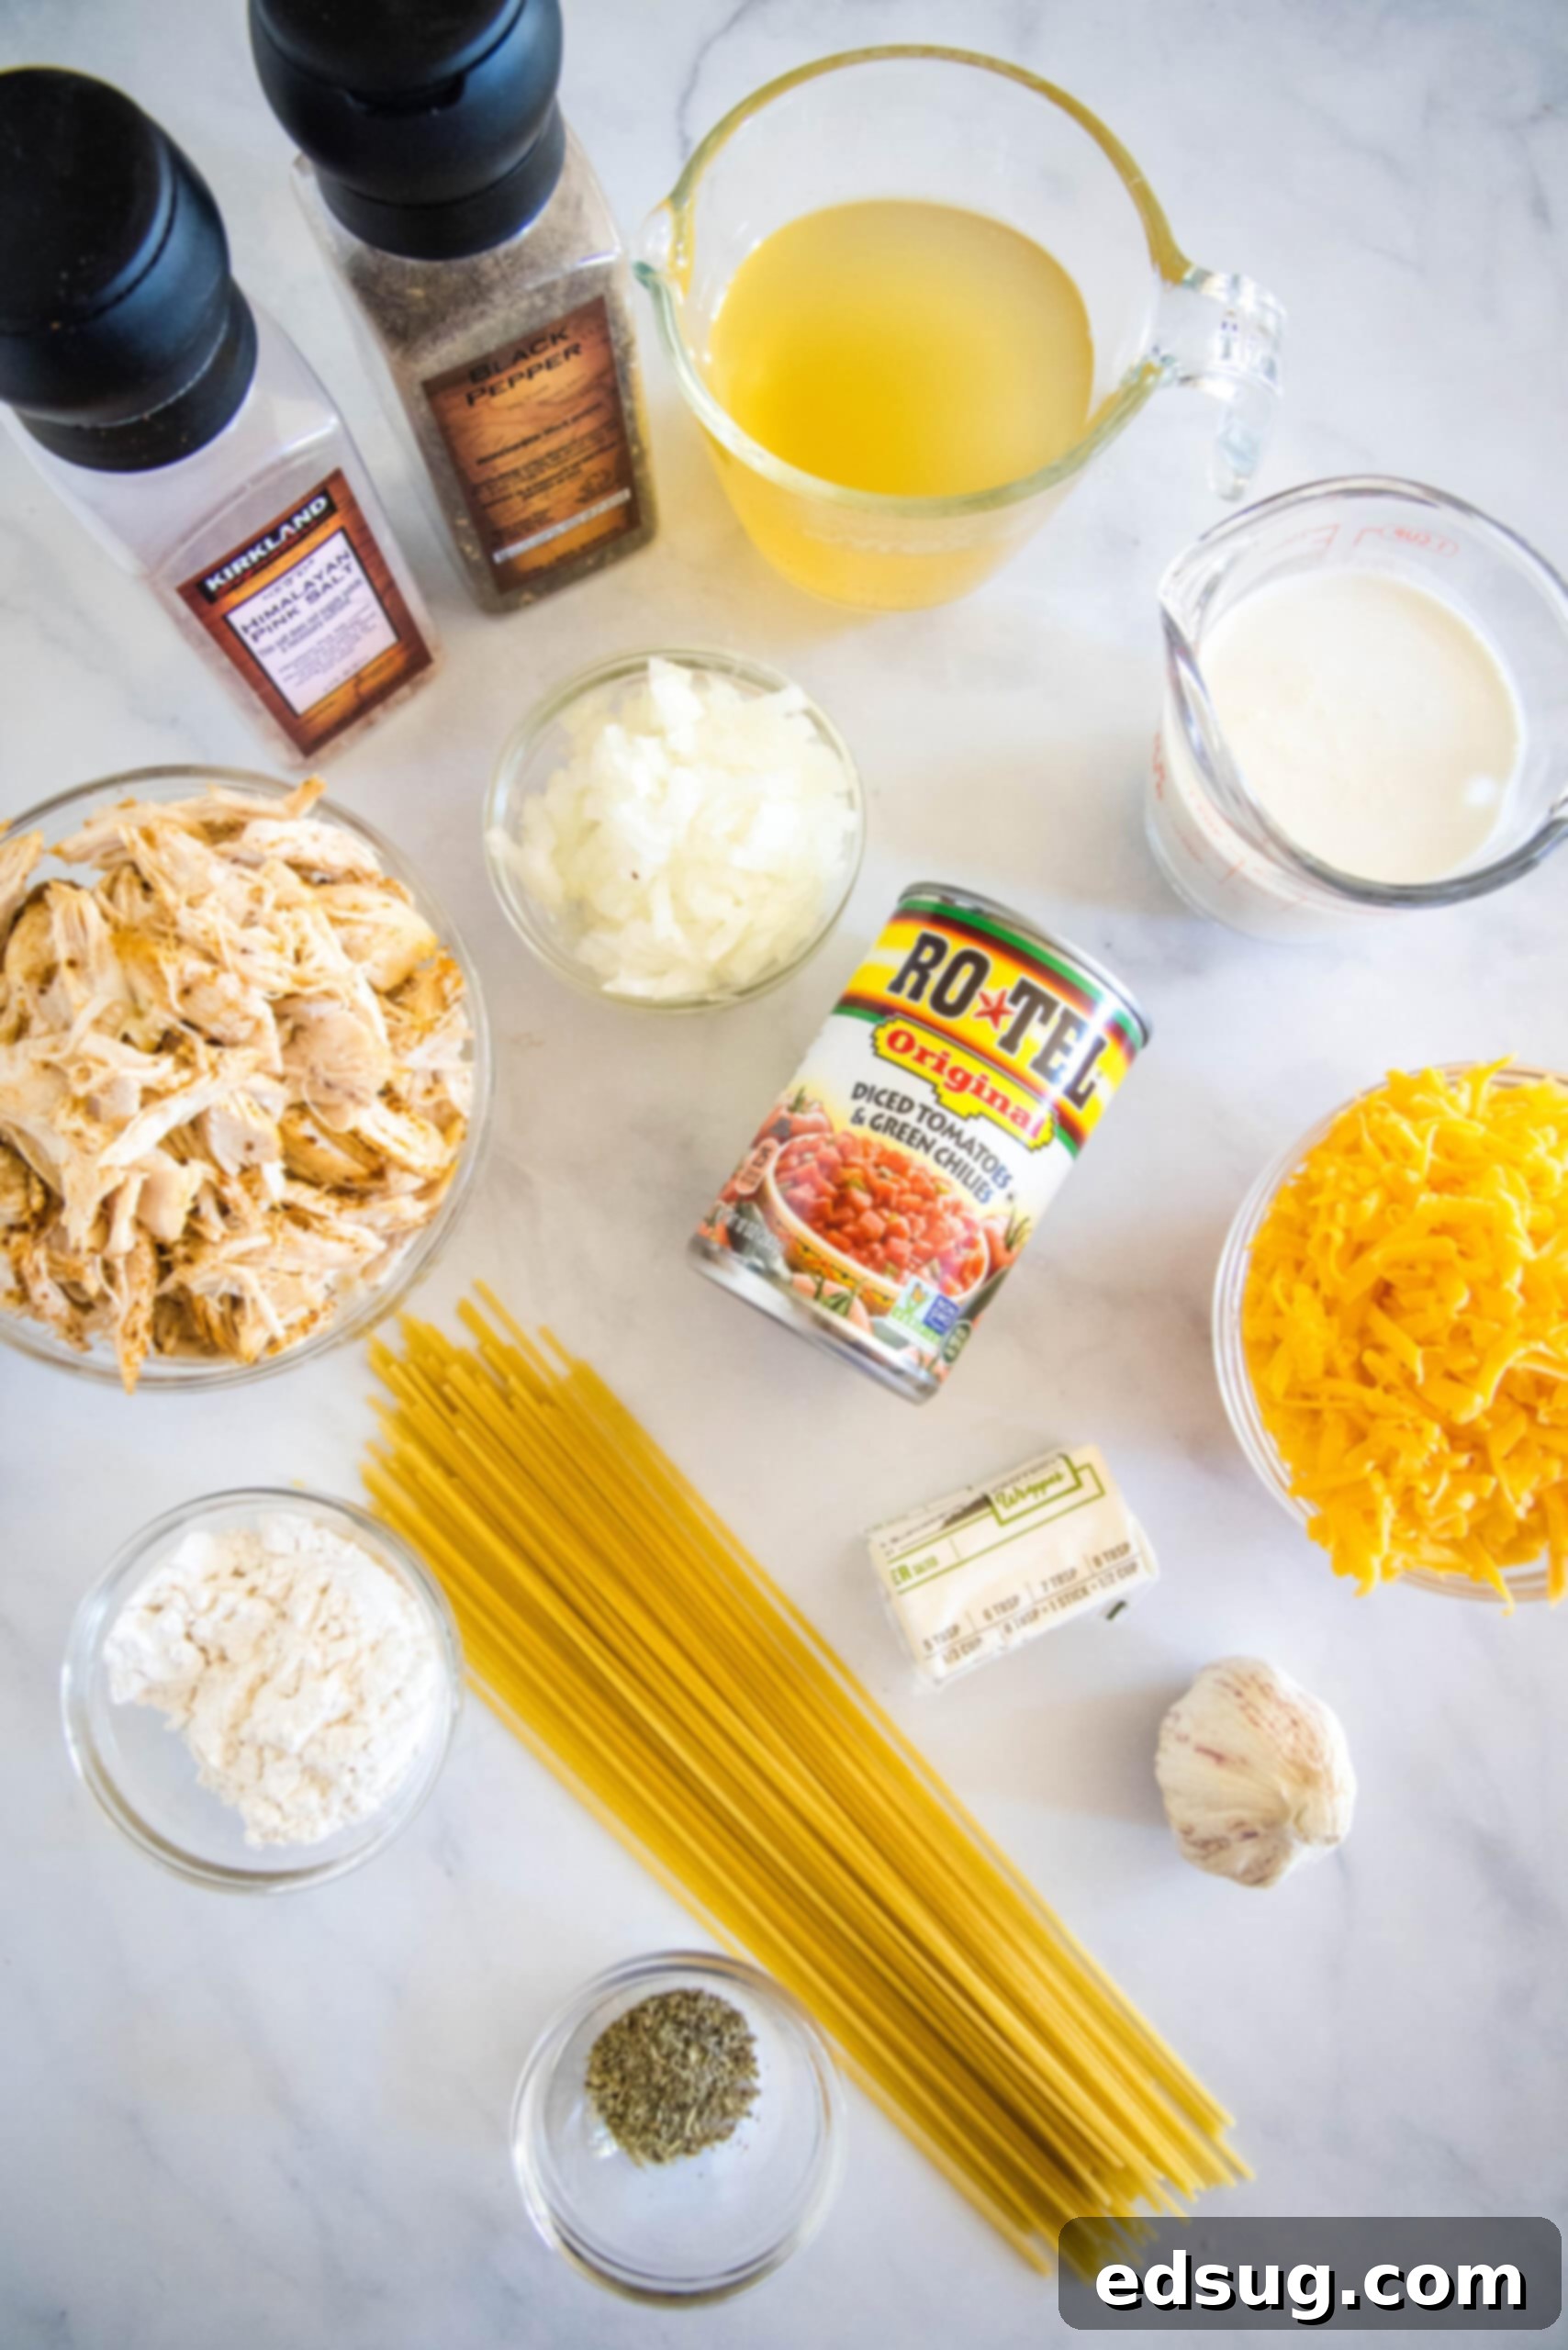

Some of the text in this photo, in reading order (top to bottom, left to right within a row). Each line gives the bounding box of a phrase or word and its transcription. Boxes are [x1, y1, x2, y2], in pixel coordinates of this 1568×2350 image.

[465, 342, 583, 407] PEPPER
[469, 326, 569, 384] BLACK
[204, 496, 329, 593] KIRKLAND
[241, 550, 352, 635] HIMALAYAN
[251, 606, 300, 642] PINK
[306, 563, 353, 605] SALT
[886, 1029, 1047, 1140] Original
[850, 1107, 993, 1204] & GREEN CHILIES
[851, 1081, 1013, 1191] DICED TOMATOES
